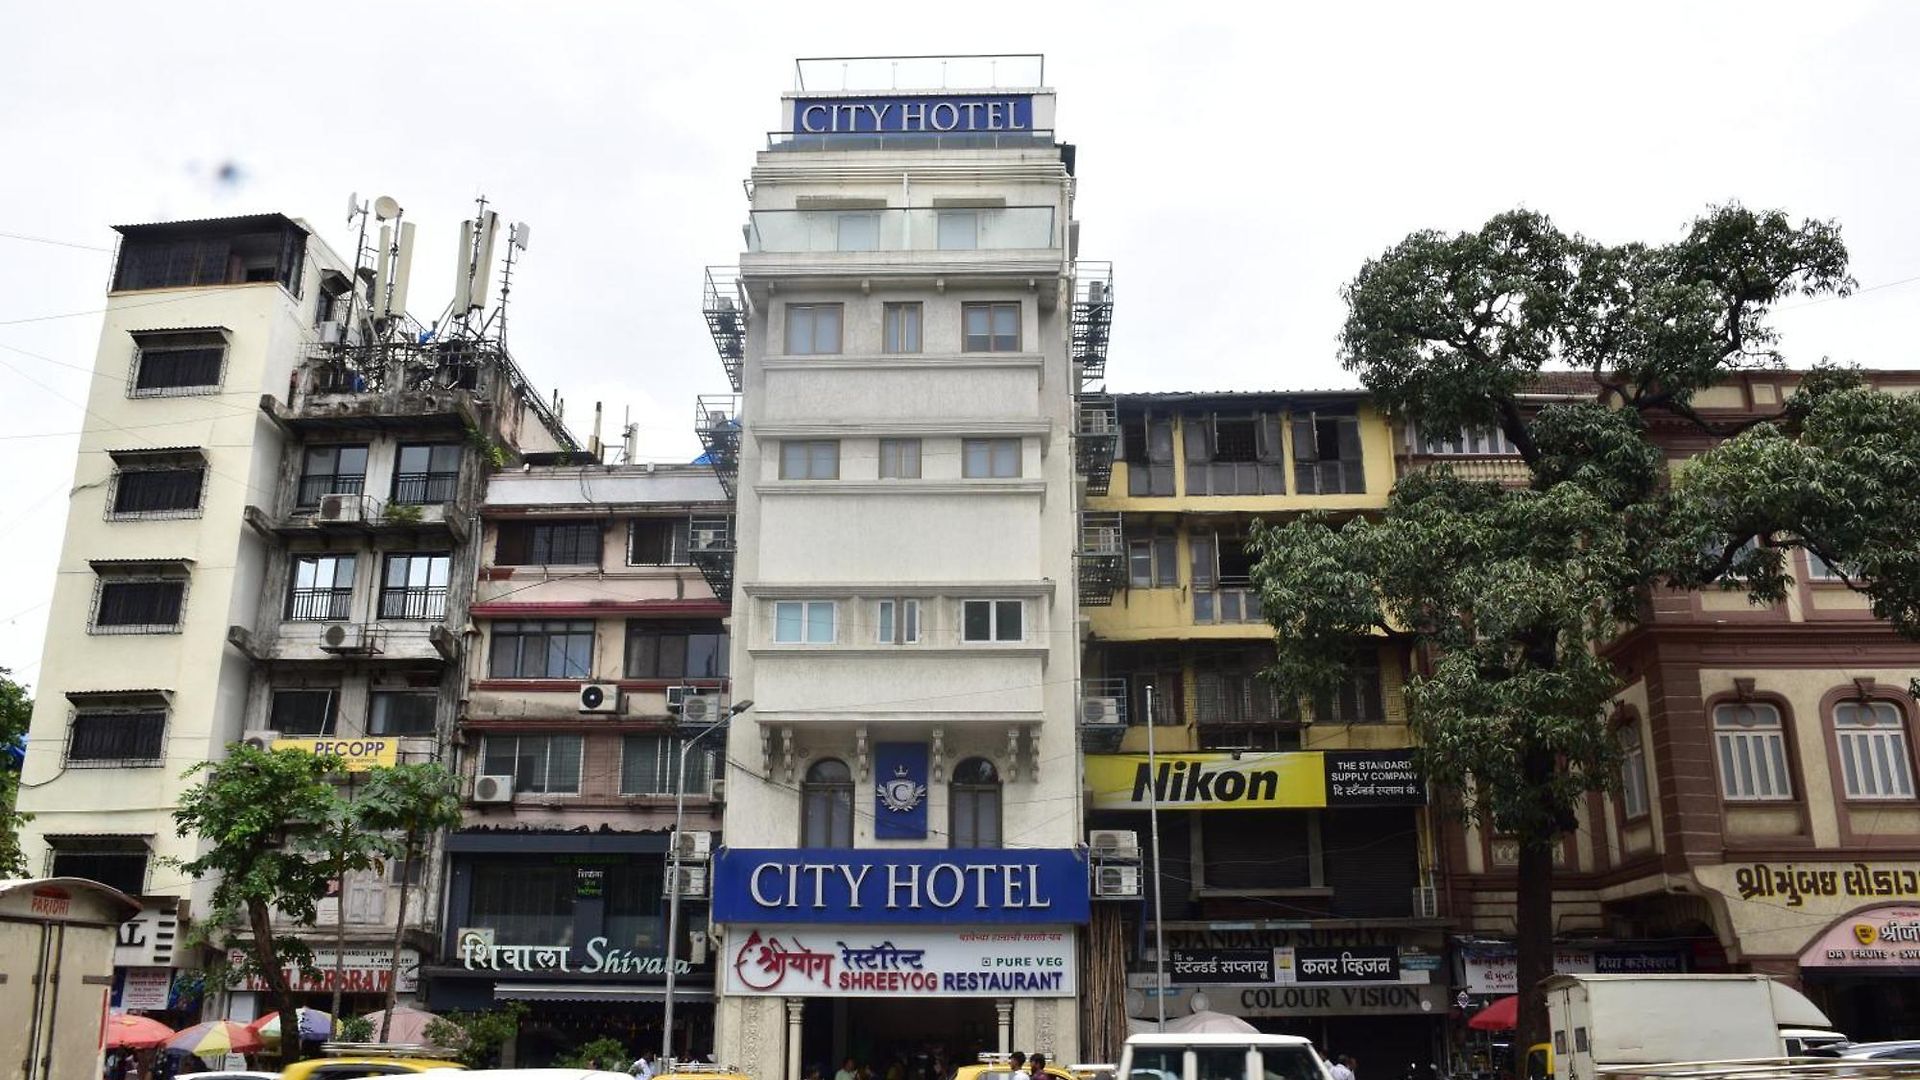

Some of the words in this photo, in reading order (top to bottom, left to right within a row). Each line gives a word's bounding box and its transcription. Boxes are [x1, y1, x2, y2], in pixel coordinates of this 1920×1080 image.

[801, 103, 893, 133] CITY
[902, 101, 1025, 132] HOTEL
[1331, 772, 1369, 781] SUPPLY
[1371, 771, 1418, 780] COMPANY
[1337, 761, 1357, 770] THE
[1359, 760, 1412, 770] STANDARD
[1131, 761, 1278, 801] Nikon
[749, 862, 874, 909] CITY
[884, 862, 1051, 909] HOTEL
[462, 932, 571, 973] शिवाला
[580, 936, 691, 975] Shivaa
[756, 936, 835, 990] श्रीयोग
[996, 957, 1032, 967] PURE
[1036, 957, 1063, 967] VEG
[1852, 949, 1889, 959] FRUITS
[1221, 960, 1269, 975] सप्लाय
[1301, 957, 1338, 975] कलर
[838, 971, 938, 991] SHREEYOG
[943, 971, 1063, 991] RESTAURANT
[1241, 988, 1331, 1009] COLOUR
[1340, 984, 1421, 1008] VISION
